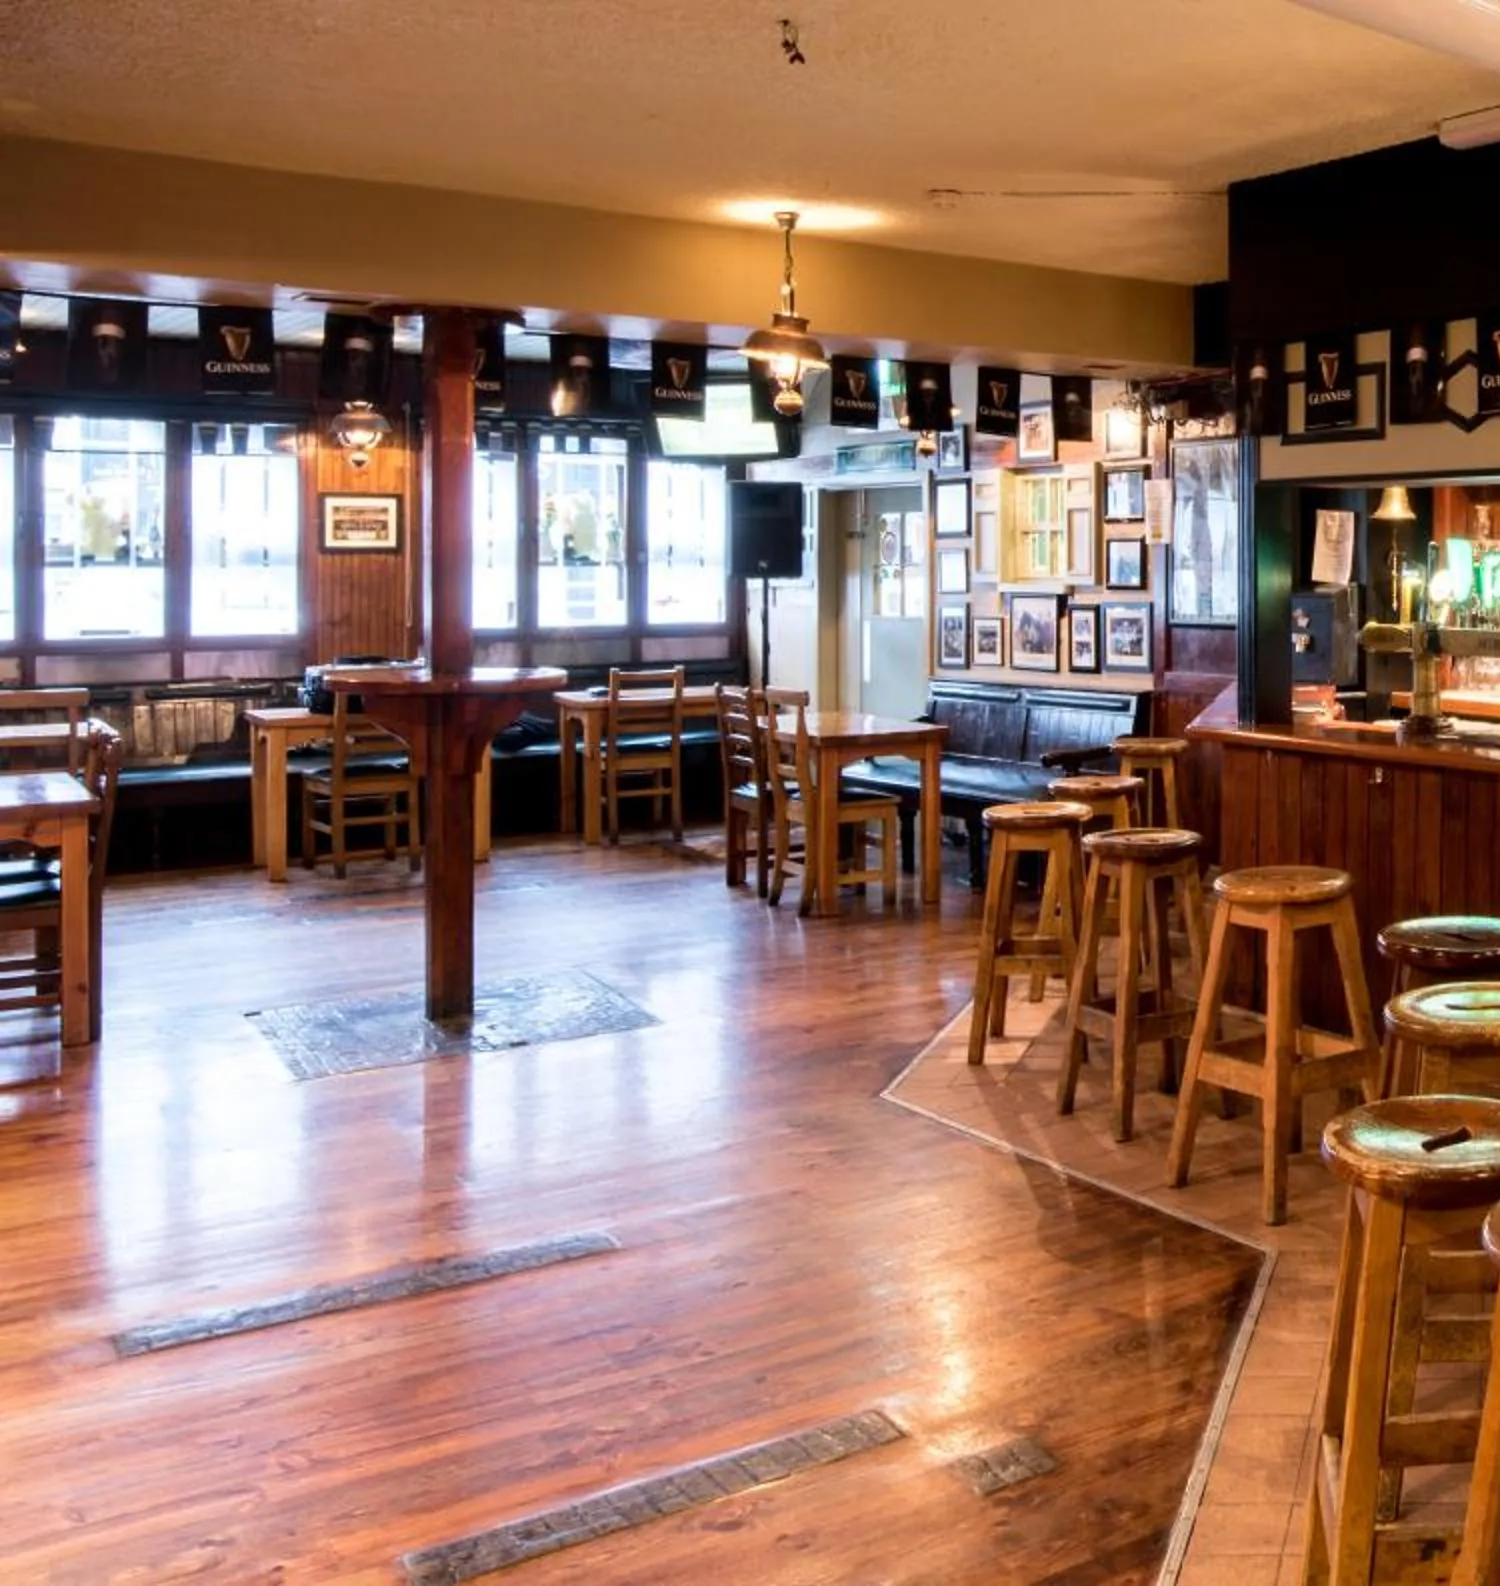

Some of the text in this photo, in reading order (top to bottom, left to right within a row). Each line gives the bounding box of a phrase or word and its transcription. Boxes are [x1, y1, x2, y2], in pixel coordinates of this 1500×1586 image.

[205, 360, 271, 374] GUINNESS
[655, 386, 704, 401] GUINNESS
[1308, 389, 1352, 405] GUINNESS
[833, 397, 877, 412] GUINNESS
